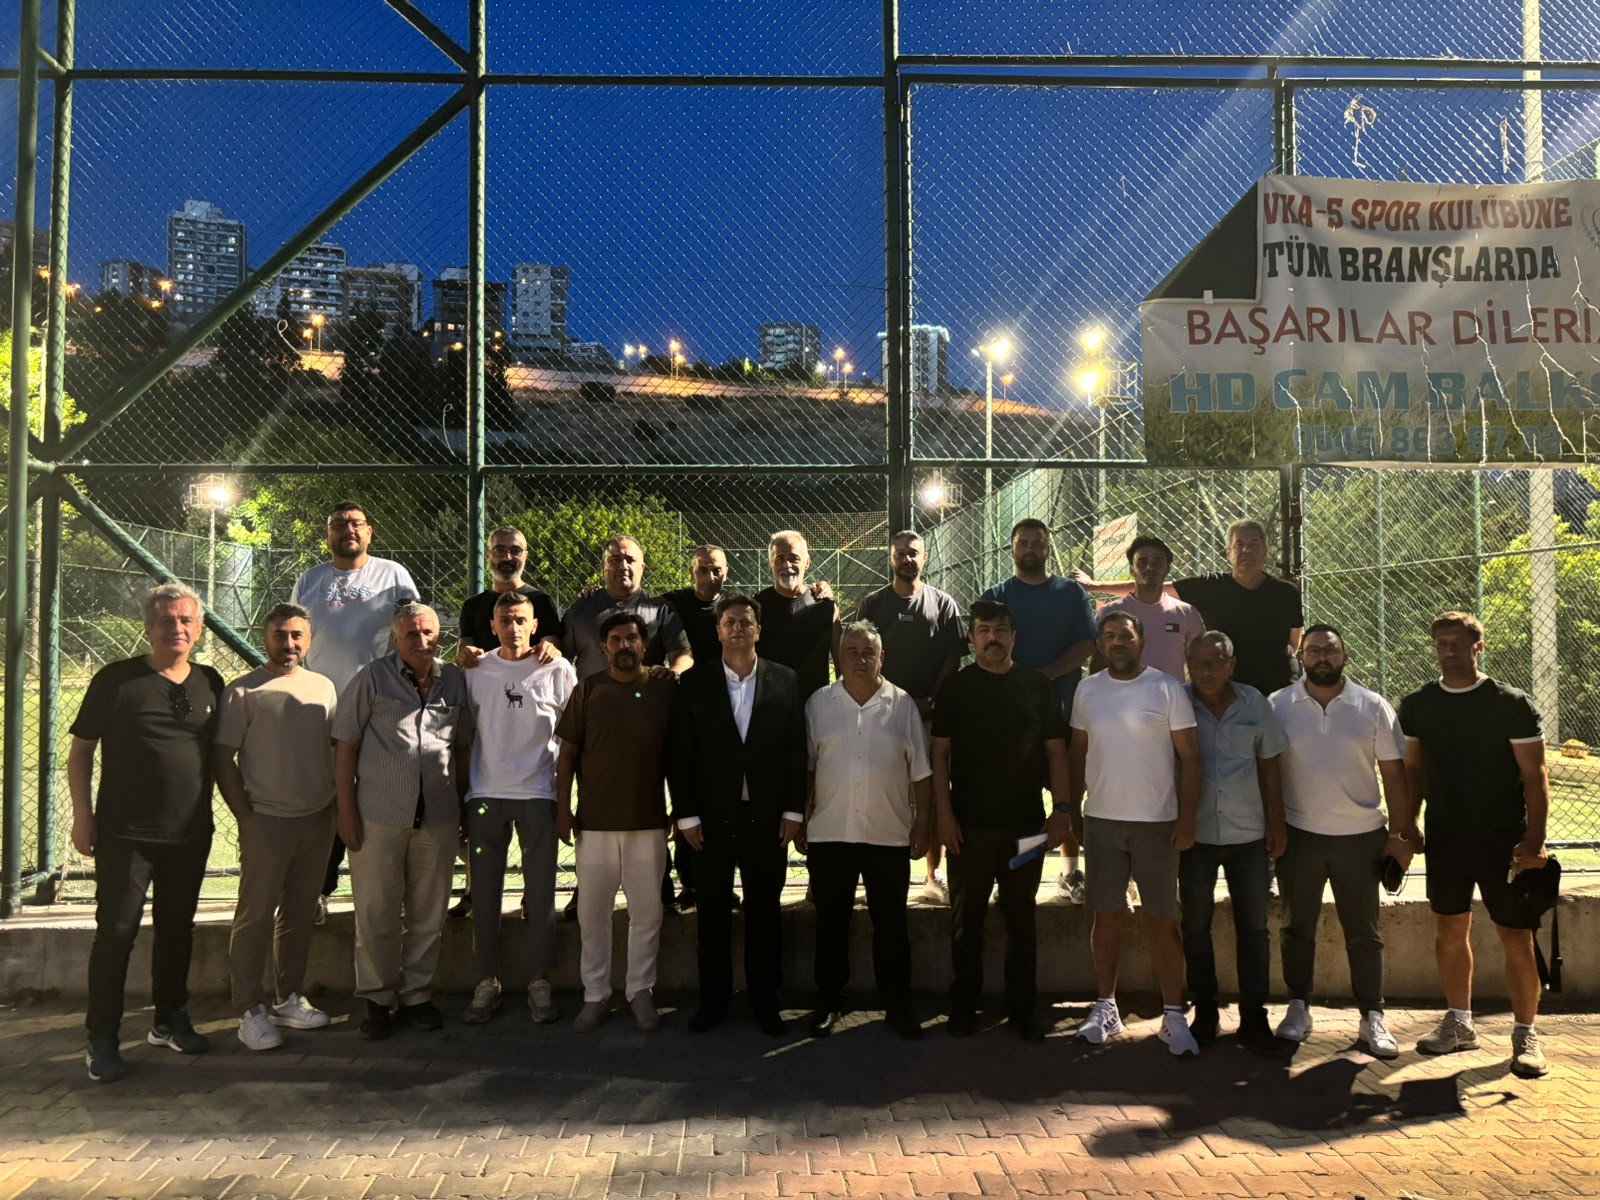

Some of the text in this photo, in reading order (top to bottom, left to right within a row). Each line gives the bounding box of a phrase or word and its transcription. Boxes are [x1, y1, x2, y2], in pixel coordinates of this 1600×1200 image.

[1351, 198, 1421, 232] SPOR
[1428, 194, 1573, 231] KULÜBÜNE
[1263, 234, 1562, 289] TÜM BRANŞLARDA
[1187, 299, 1600, 356] BAŞARILAR DİLERİ
[1169, 371, 1257, 414] HD
[1273, 369, 1411, 411] CAM
